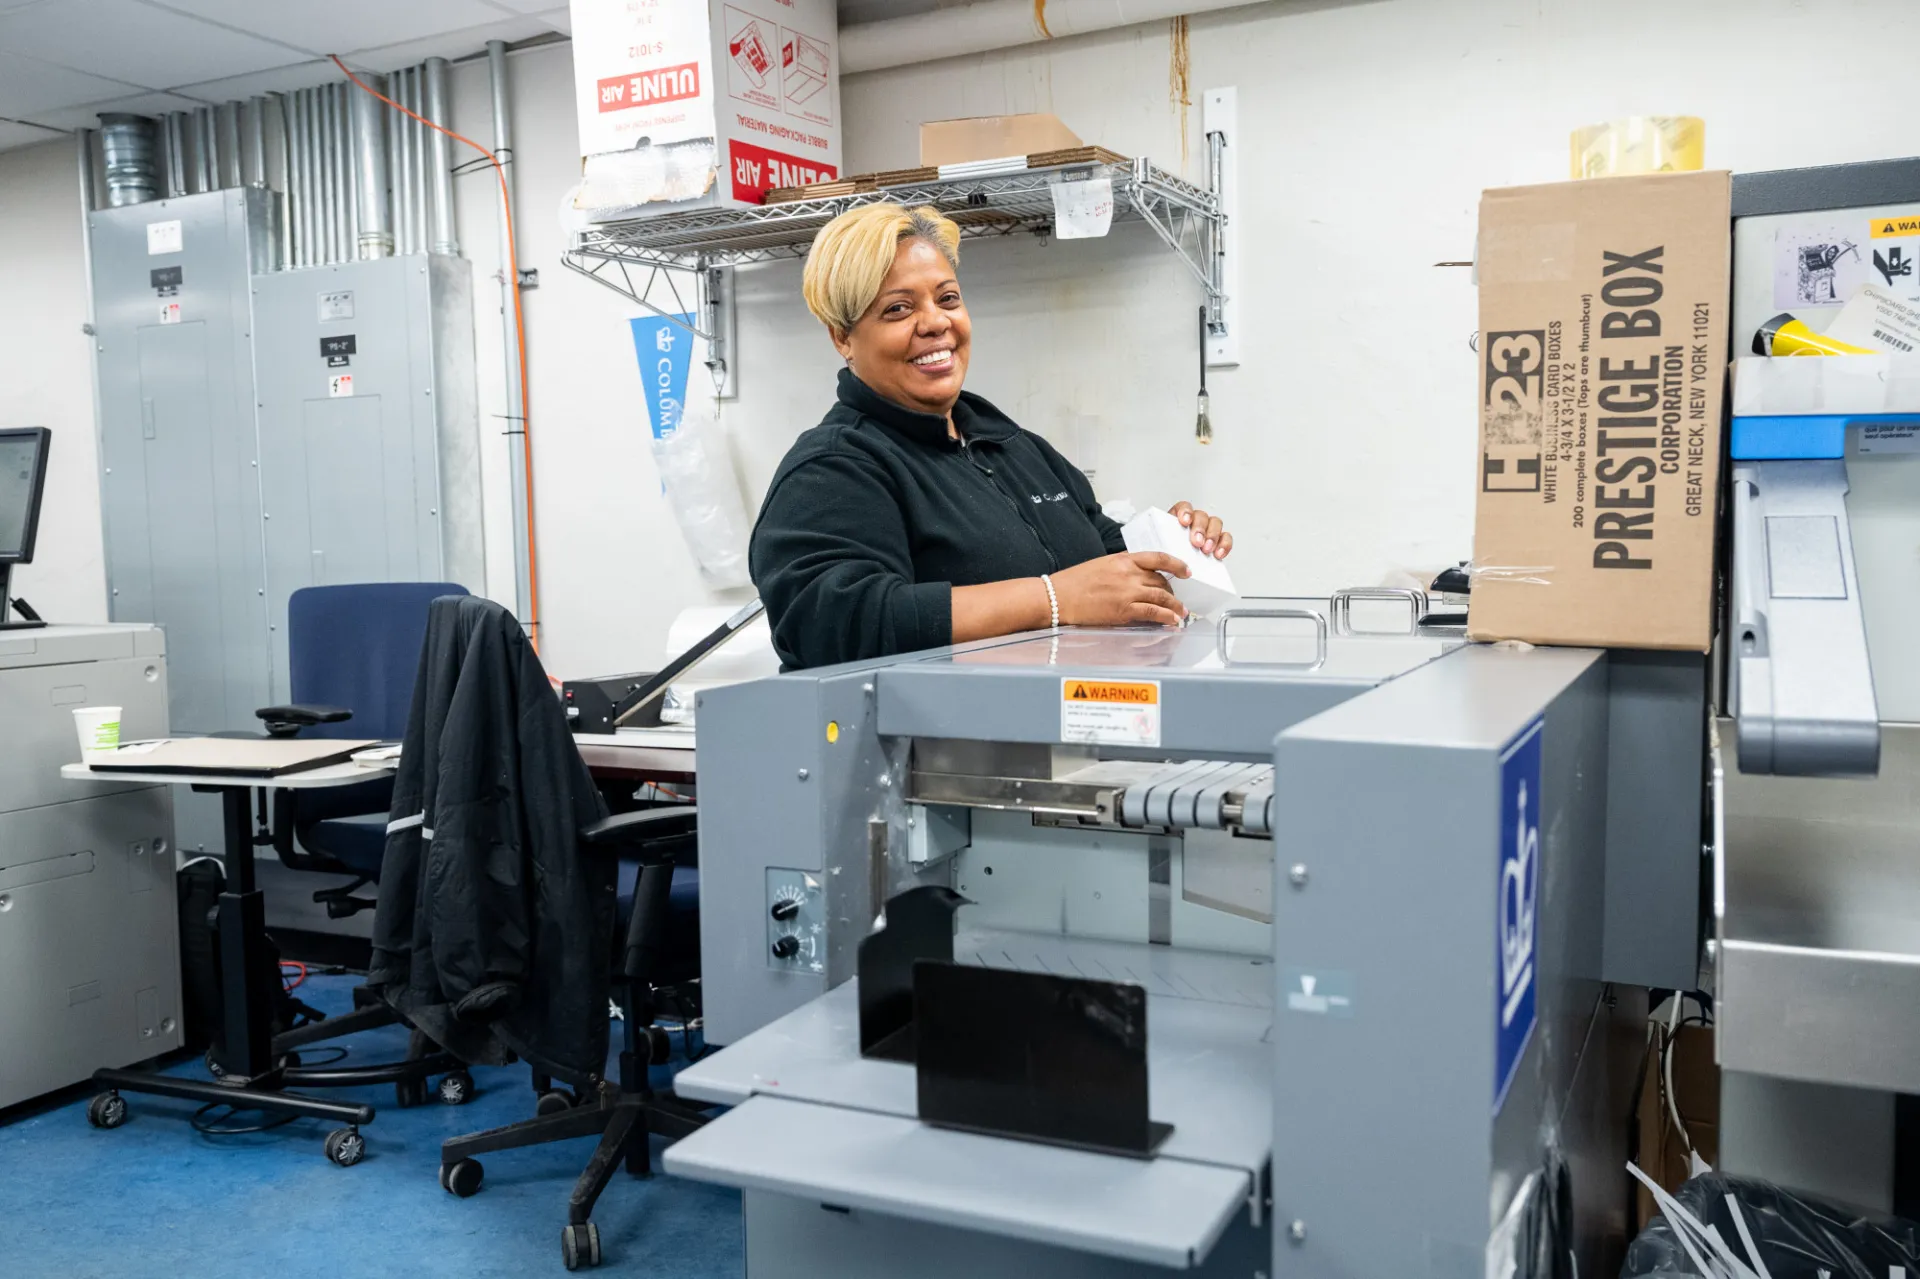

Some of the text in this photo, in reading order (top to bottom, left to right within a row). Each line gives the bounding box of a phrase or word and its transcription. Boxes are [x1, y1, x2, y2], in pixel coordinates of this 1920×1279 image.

[629, 41, 663, 58] S-1012
[601, 68, 695, 104] ULINE AIR
[736, 113, 828, 150] BUBBLE PACKAGING MATERIAL
[735, 157, 761, 188] AIR
[1898, 221, 1920, 231] WA
[1579, 293, 1593, 352] thumbcut)
[1549, 320, 1561, 360] BOXES
[1547, 366, 1560, 397] CARD
[1563, 374, 1575, 382] X
[1562, 386, 1574, 415] 3-1/2
[1578, 382, 1590, 410] (Tops
[1593, 246, 1664, 569] PRESTIGE BOX
[1660, 346, 1684, 475] CORPORATION
[1686, 302, 1709, 517] GREAT NECK, NEW YORK 11021
[1562, 419, 1573, 427] X
[1577, 412, 1587, 442] boxes
[1561, 430, 1573, 462] 4-3/4
[1544, 465, 1557, 503] WHITE
[1575, 444, 1588, 503] complete
[1573, 505, 1583, 528] 200
[1089, 687, 1149, 702] WARNING
